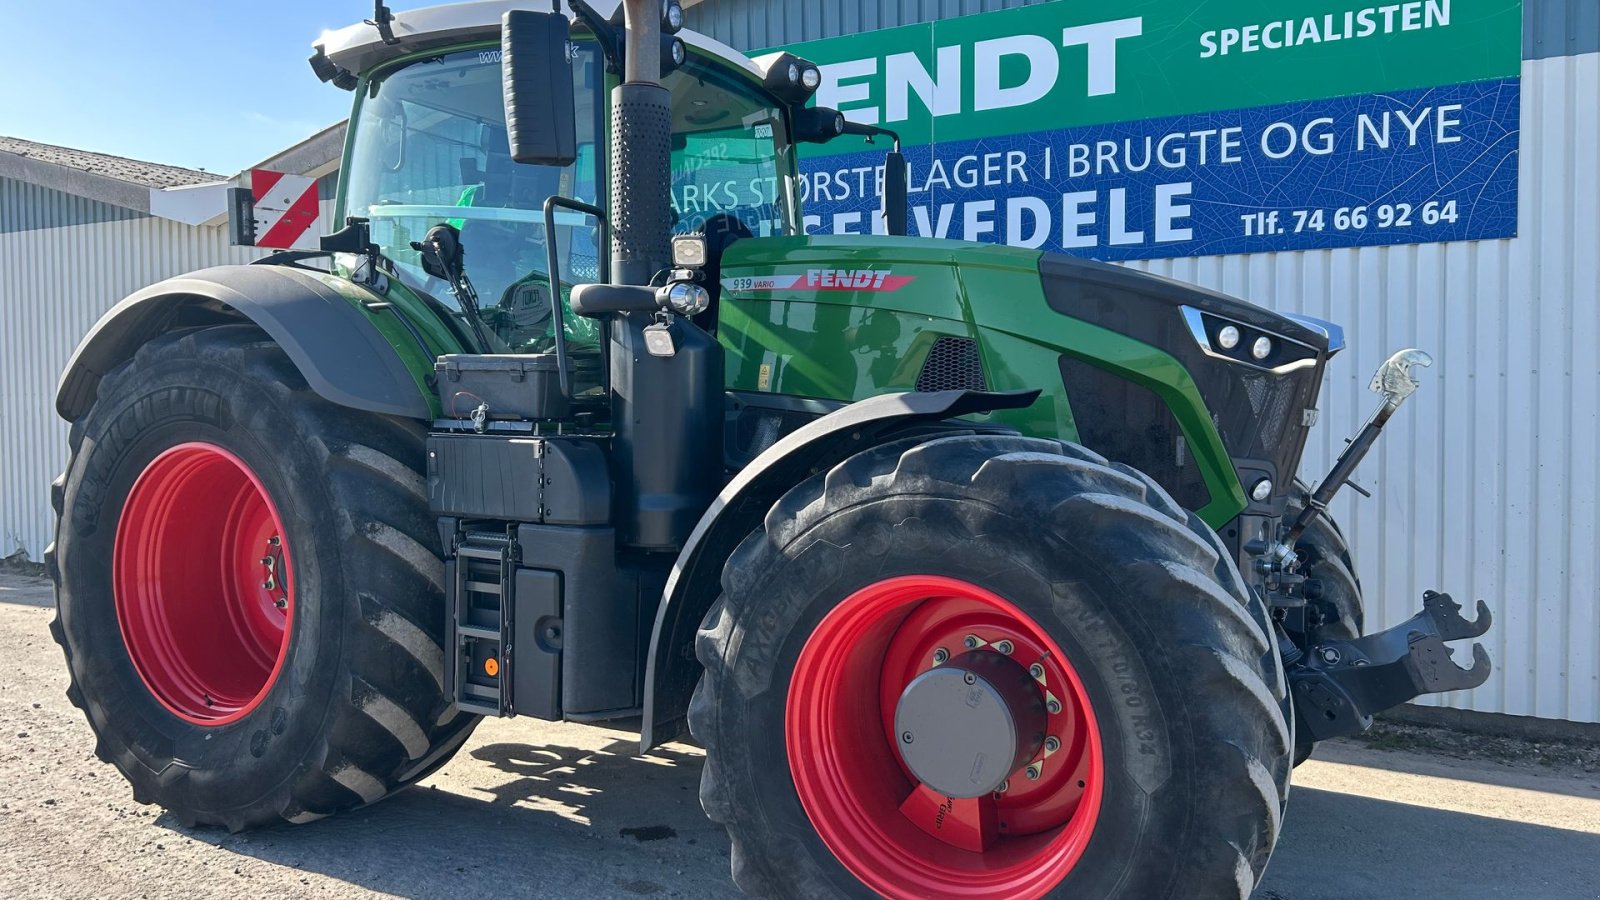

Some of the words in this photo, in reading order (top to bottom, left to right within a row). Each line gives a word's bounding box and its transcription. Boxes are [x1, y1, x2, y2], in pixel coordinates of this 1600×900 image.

[1200, 0, 1451, 58] SPECIALISTEN
[816, 17, 1142, 126] ENDT
[907, 150, 1028, 193] LAGER
[1044, 148, 1051, 180] I
[1069, 127, 1242, 179] BRUGTE
[1261, 117, 1334, 159] OG
[1356, 104, 1462, 151] NYE
[1241, 212, 1284, 236] Tlf.
[1293, 209, 1325, 234] 74
[1334, 206, 1368, 230] 66
[1377, 203, 1412, 228] 92
[1421, 200, 1458, 225] 64
[733, 278, 752, 289] 939
[753, 280, 775, 289] VARIO
[807, 269, 891, 289] FENDT
